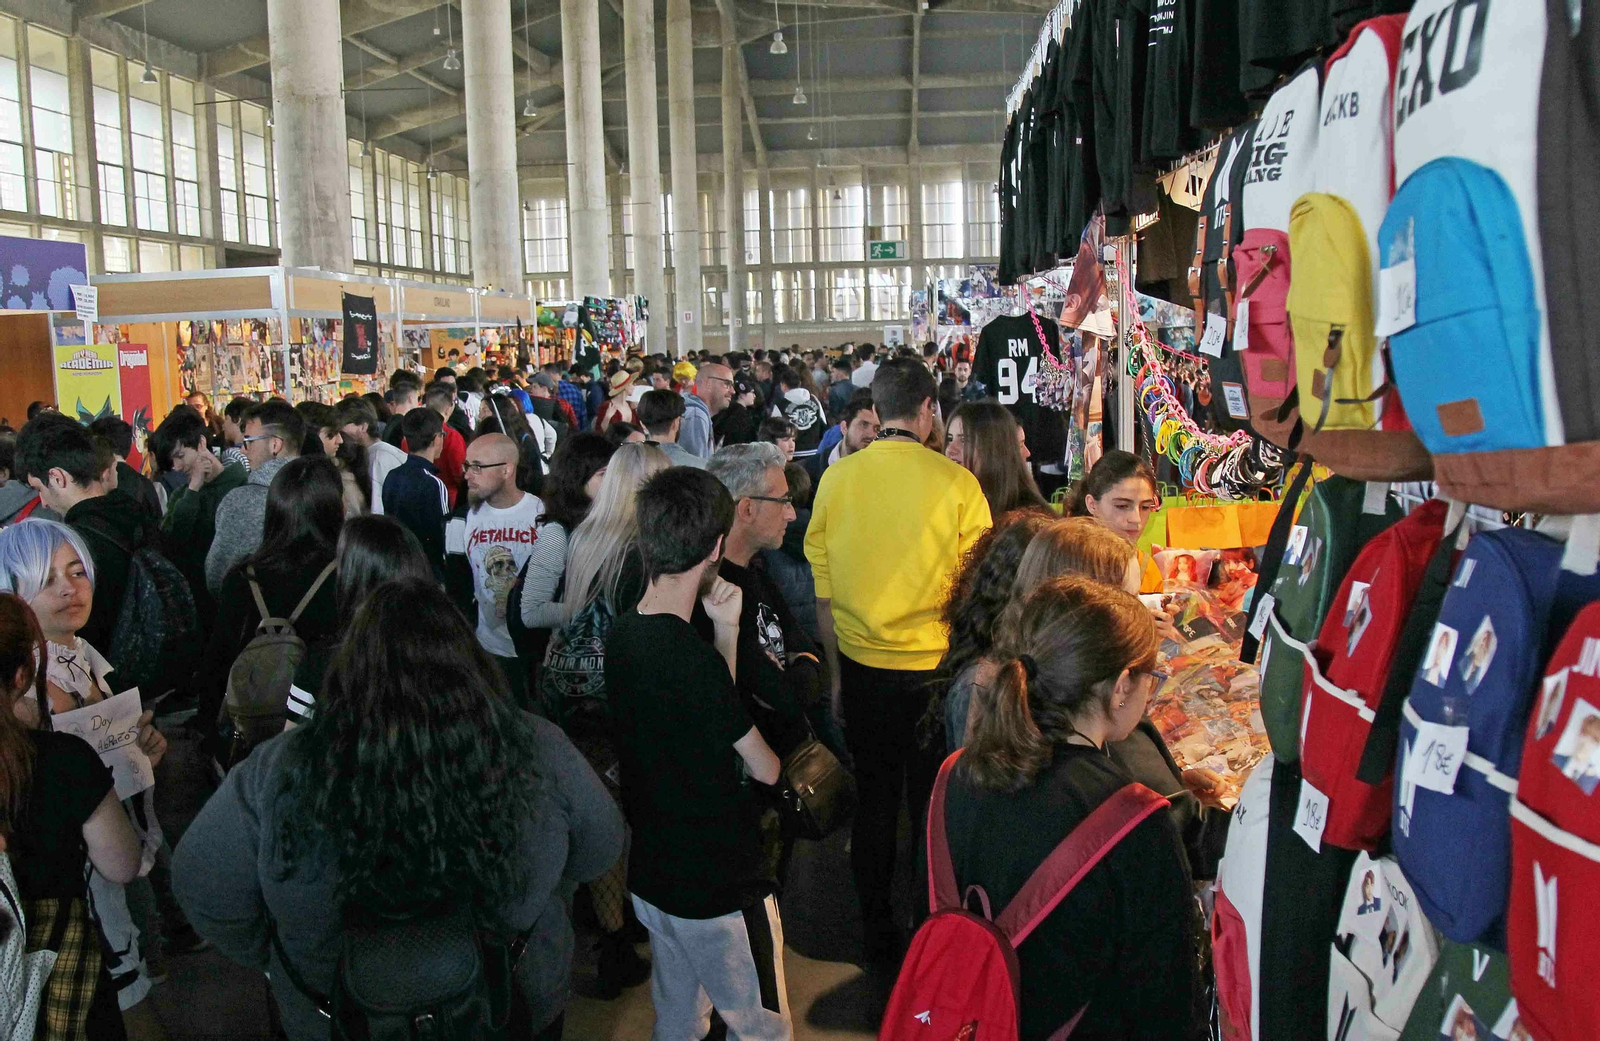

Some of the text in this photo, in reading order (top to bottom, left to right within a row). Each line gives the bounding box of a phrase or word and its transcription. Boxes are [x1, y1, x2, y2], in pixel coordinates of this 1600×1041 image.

[1251, 142, 1288, 167] IG
[1008, 338, 1029, 357] RM
[60, 358, 114, 370] ACADEMIA
[998, 357, 1038, 404] 94
[91, 715, 113, 735] Doy
[1423, 740, 1453, 775] 18€
[1303, 799, 1321, 831] 18€
[1472, 948, 1490, 982] V
